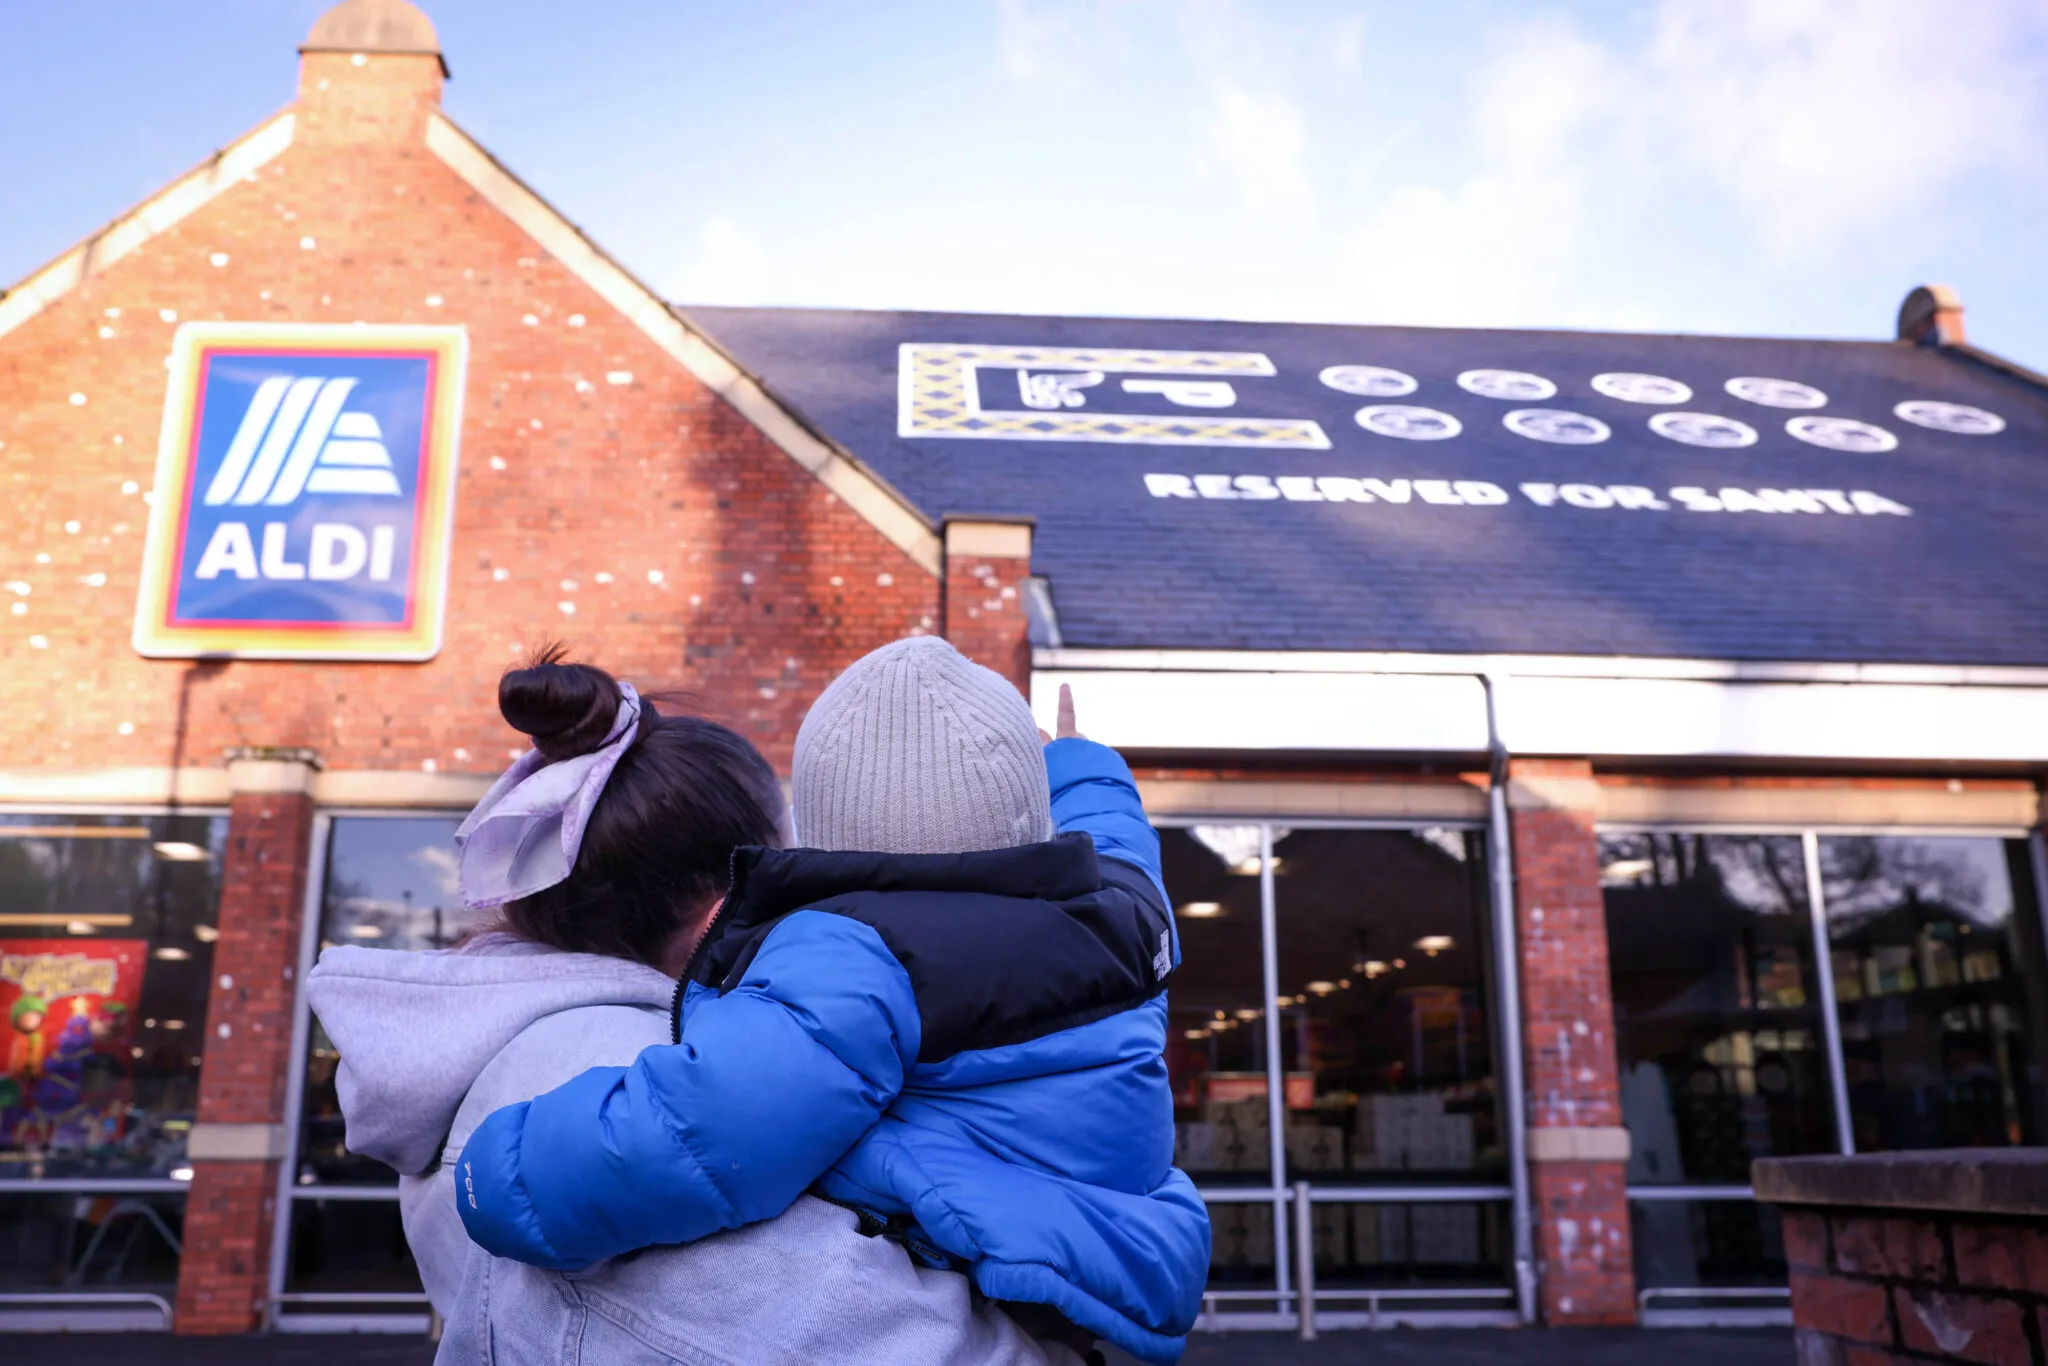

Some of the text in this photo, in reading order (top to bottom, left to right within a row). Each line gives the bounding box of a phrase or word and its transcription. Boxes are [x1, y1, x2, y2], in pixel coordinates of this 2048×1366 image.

[1120, 378, 1238, 408] P
[1143, 473, 1913, 516] RESERVED FOR SANTA
[195, 522, 396, 581] ALDI
[463, 1160, 477, 1210] 700
